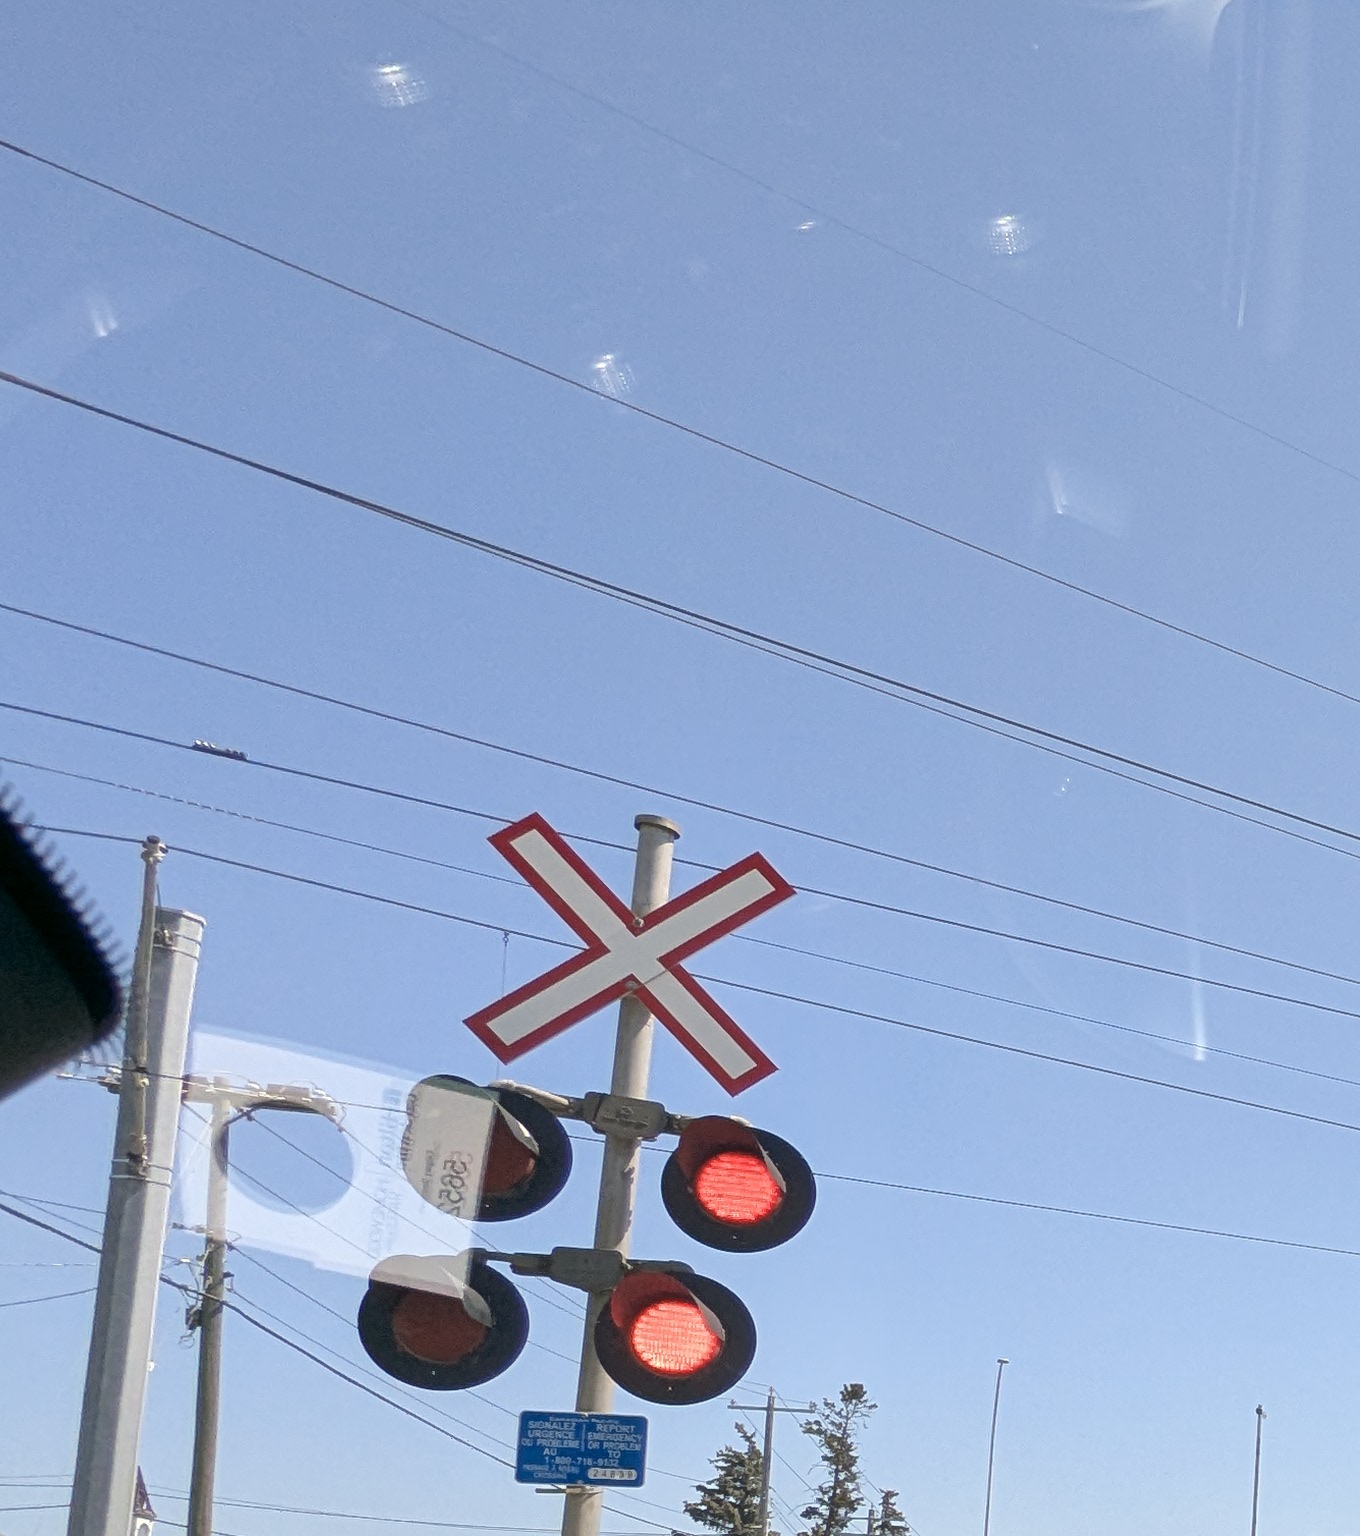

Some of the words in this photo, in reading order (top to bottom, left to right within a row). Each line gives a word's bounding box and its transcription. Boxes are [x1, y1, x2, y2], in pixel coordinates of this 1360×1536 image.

[596, 1424, 636, 1433] REPORT
[527, 1430, 576, 1440] URGENCE
[587, 1432, 643, 1443] EMERGENCY
[587, 1442, 600, 1450] OR
[602, 1442, 641, 1452] PROBLEM
[543, 1448, 558, 1456] AU
[607, 1451, 621, 1459] TO
